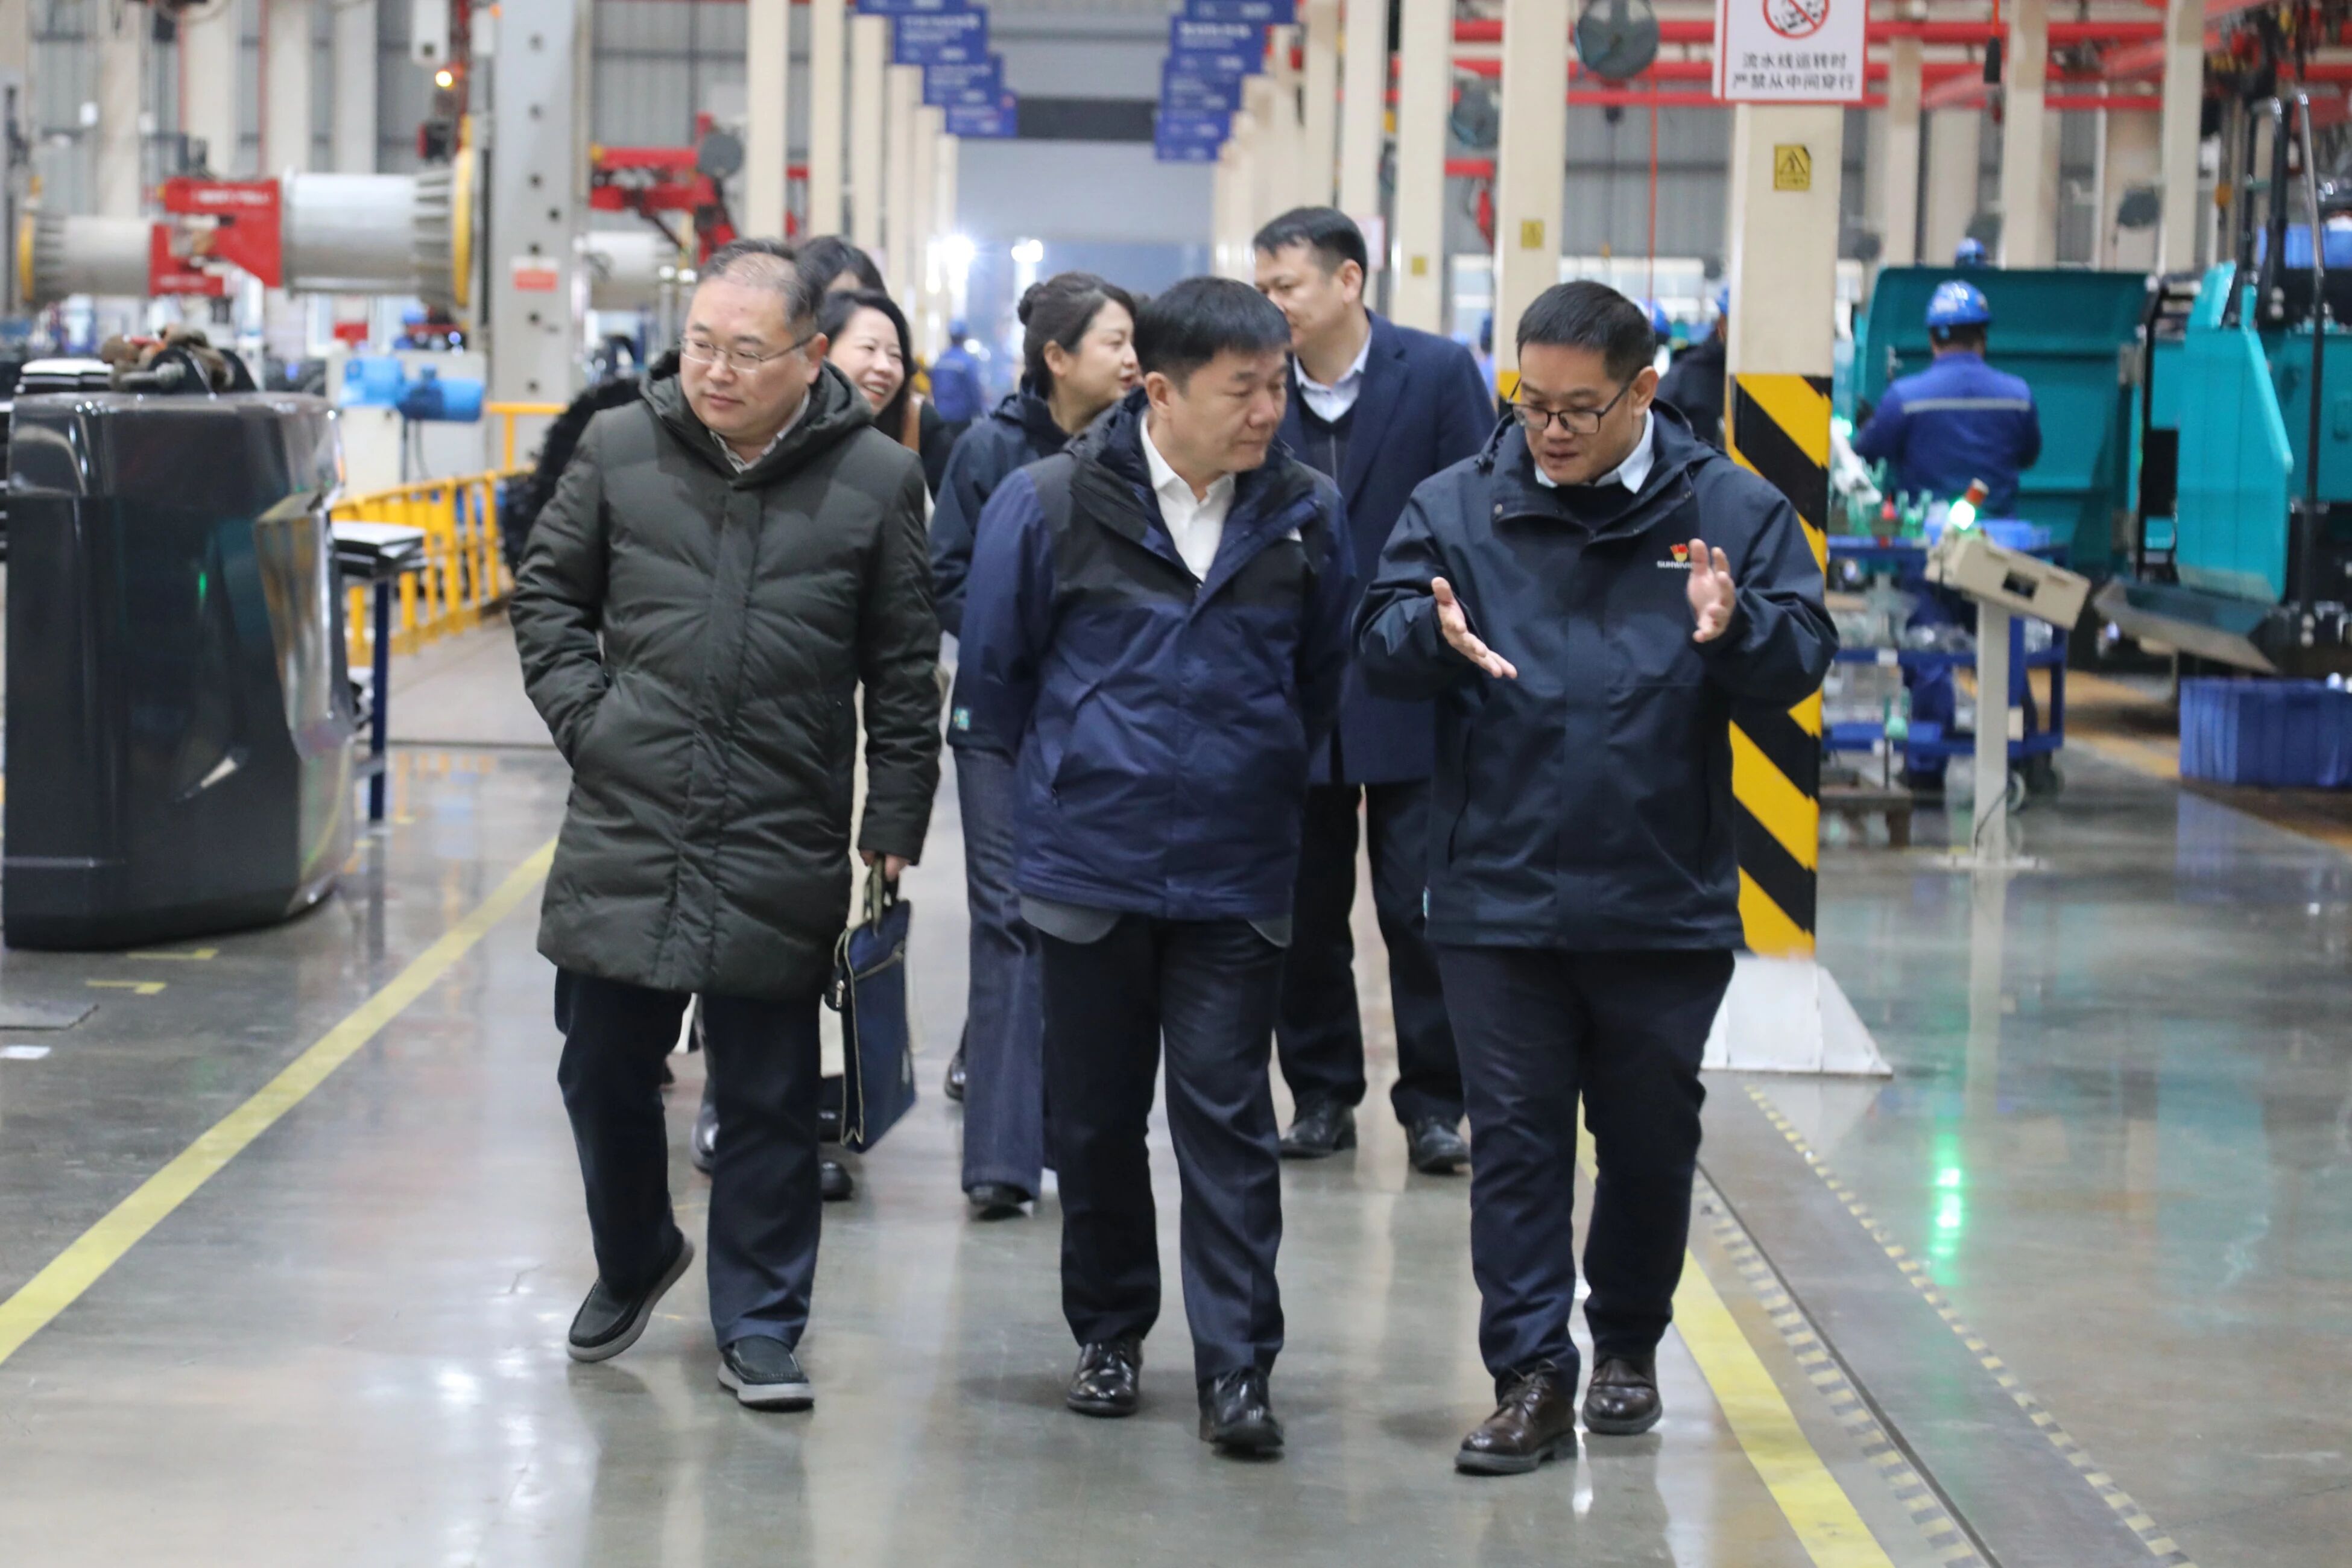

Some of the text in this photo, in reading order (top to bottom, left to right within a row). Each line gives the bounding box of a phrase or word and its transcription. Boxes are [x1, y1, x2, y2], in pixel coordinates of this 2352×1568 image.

[1742, 52, 1847, 68] 流水线运转时
[1733, 73, 1854, 89] 严禁从中间穿行
